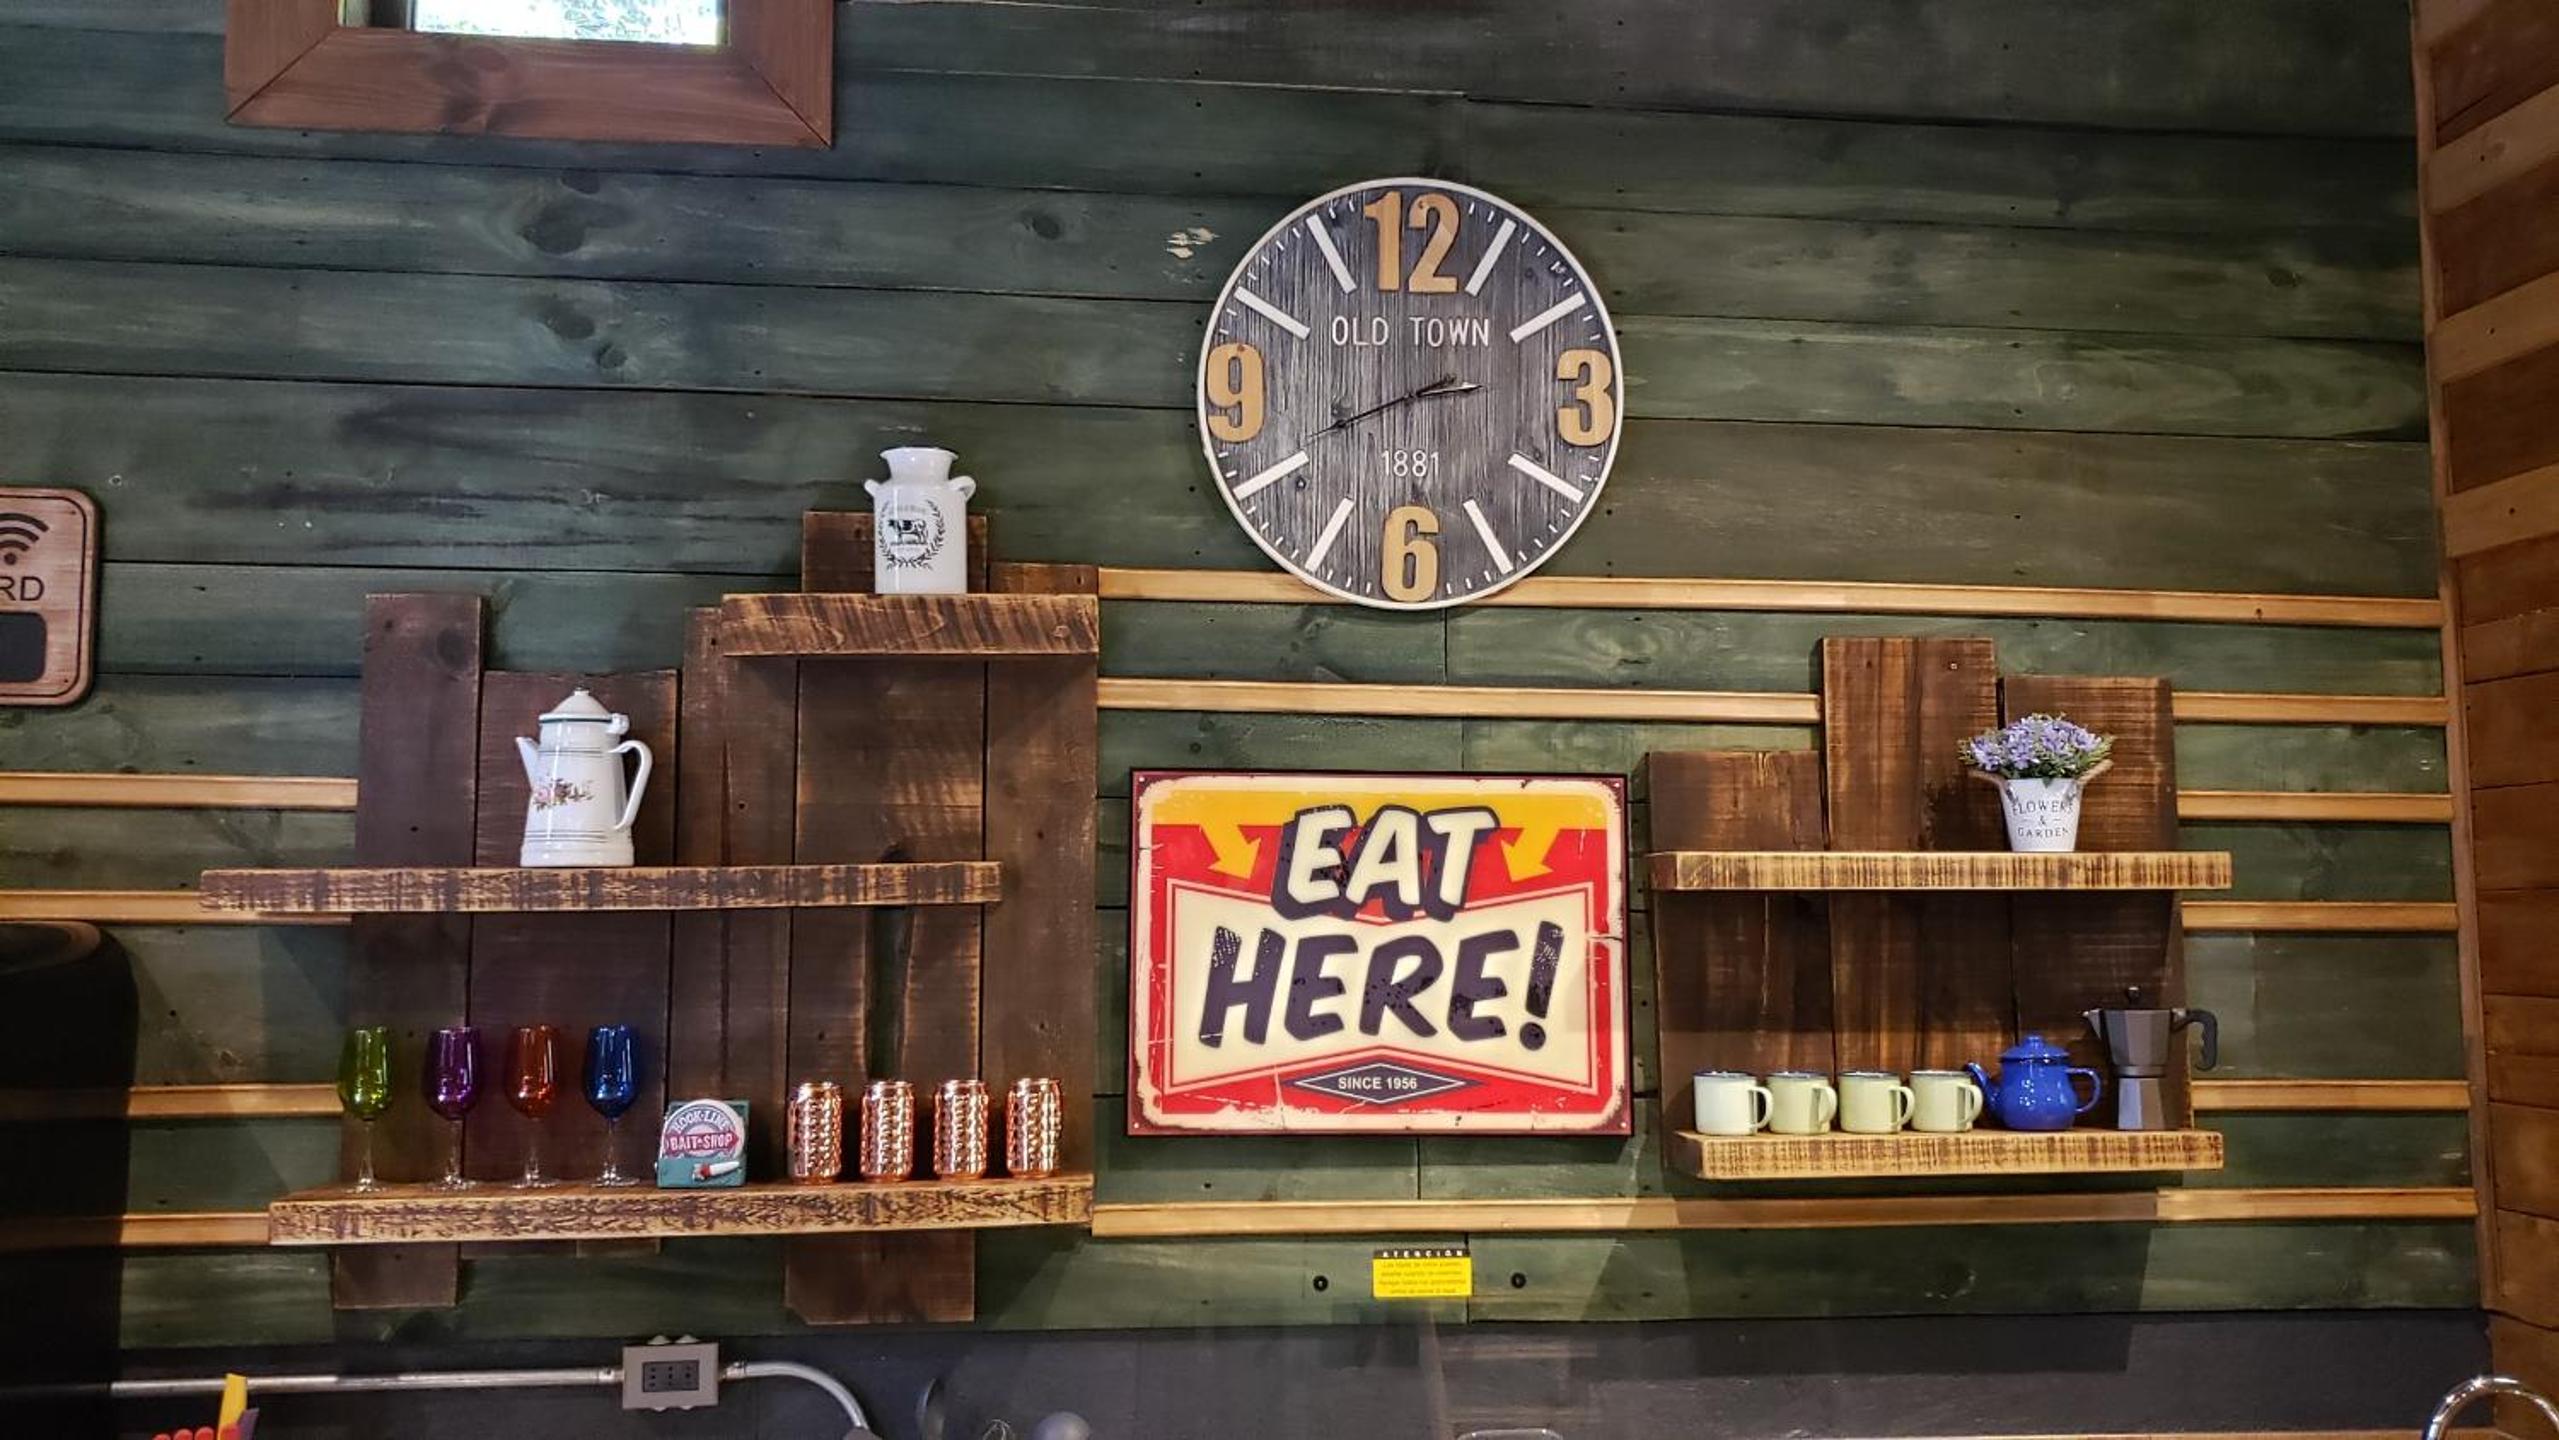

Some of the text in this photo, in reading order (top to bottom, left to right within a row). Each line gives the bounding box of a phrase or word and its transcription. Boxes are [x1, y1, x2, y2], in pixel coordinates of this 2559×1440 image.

[1363, 189, 1461, 295] 12
[1331, 315, 1489, 348] OLD TOWN
[1206, 343, 1267, 444] 9
[1556, 348, 1615, 448] 3
[1381, 449, 1440, 477] 1881
[1381, 504, 1440, 602] 6
[1275, 803, 1499, 920] EAT
[2017, 826, 2069, 838] GARDEN
[1198, 920, 1564, 1053] HERE!
[1337, 1076, 1418, 1090] SINCE 1956
